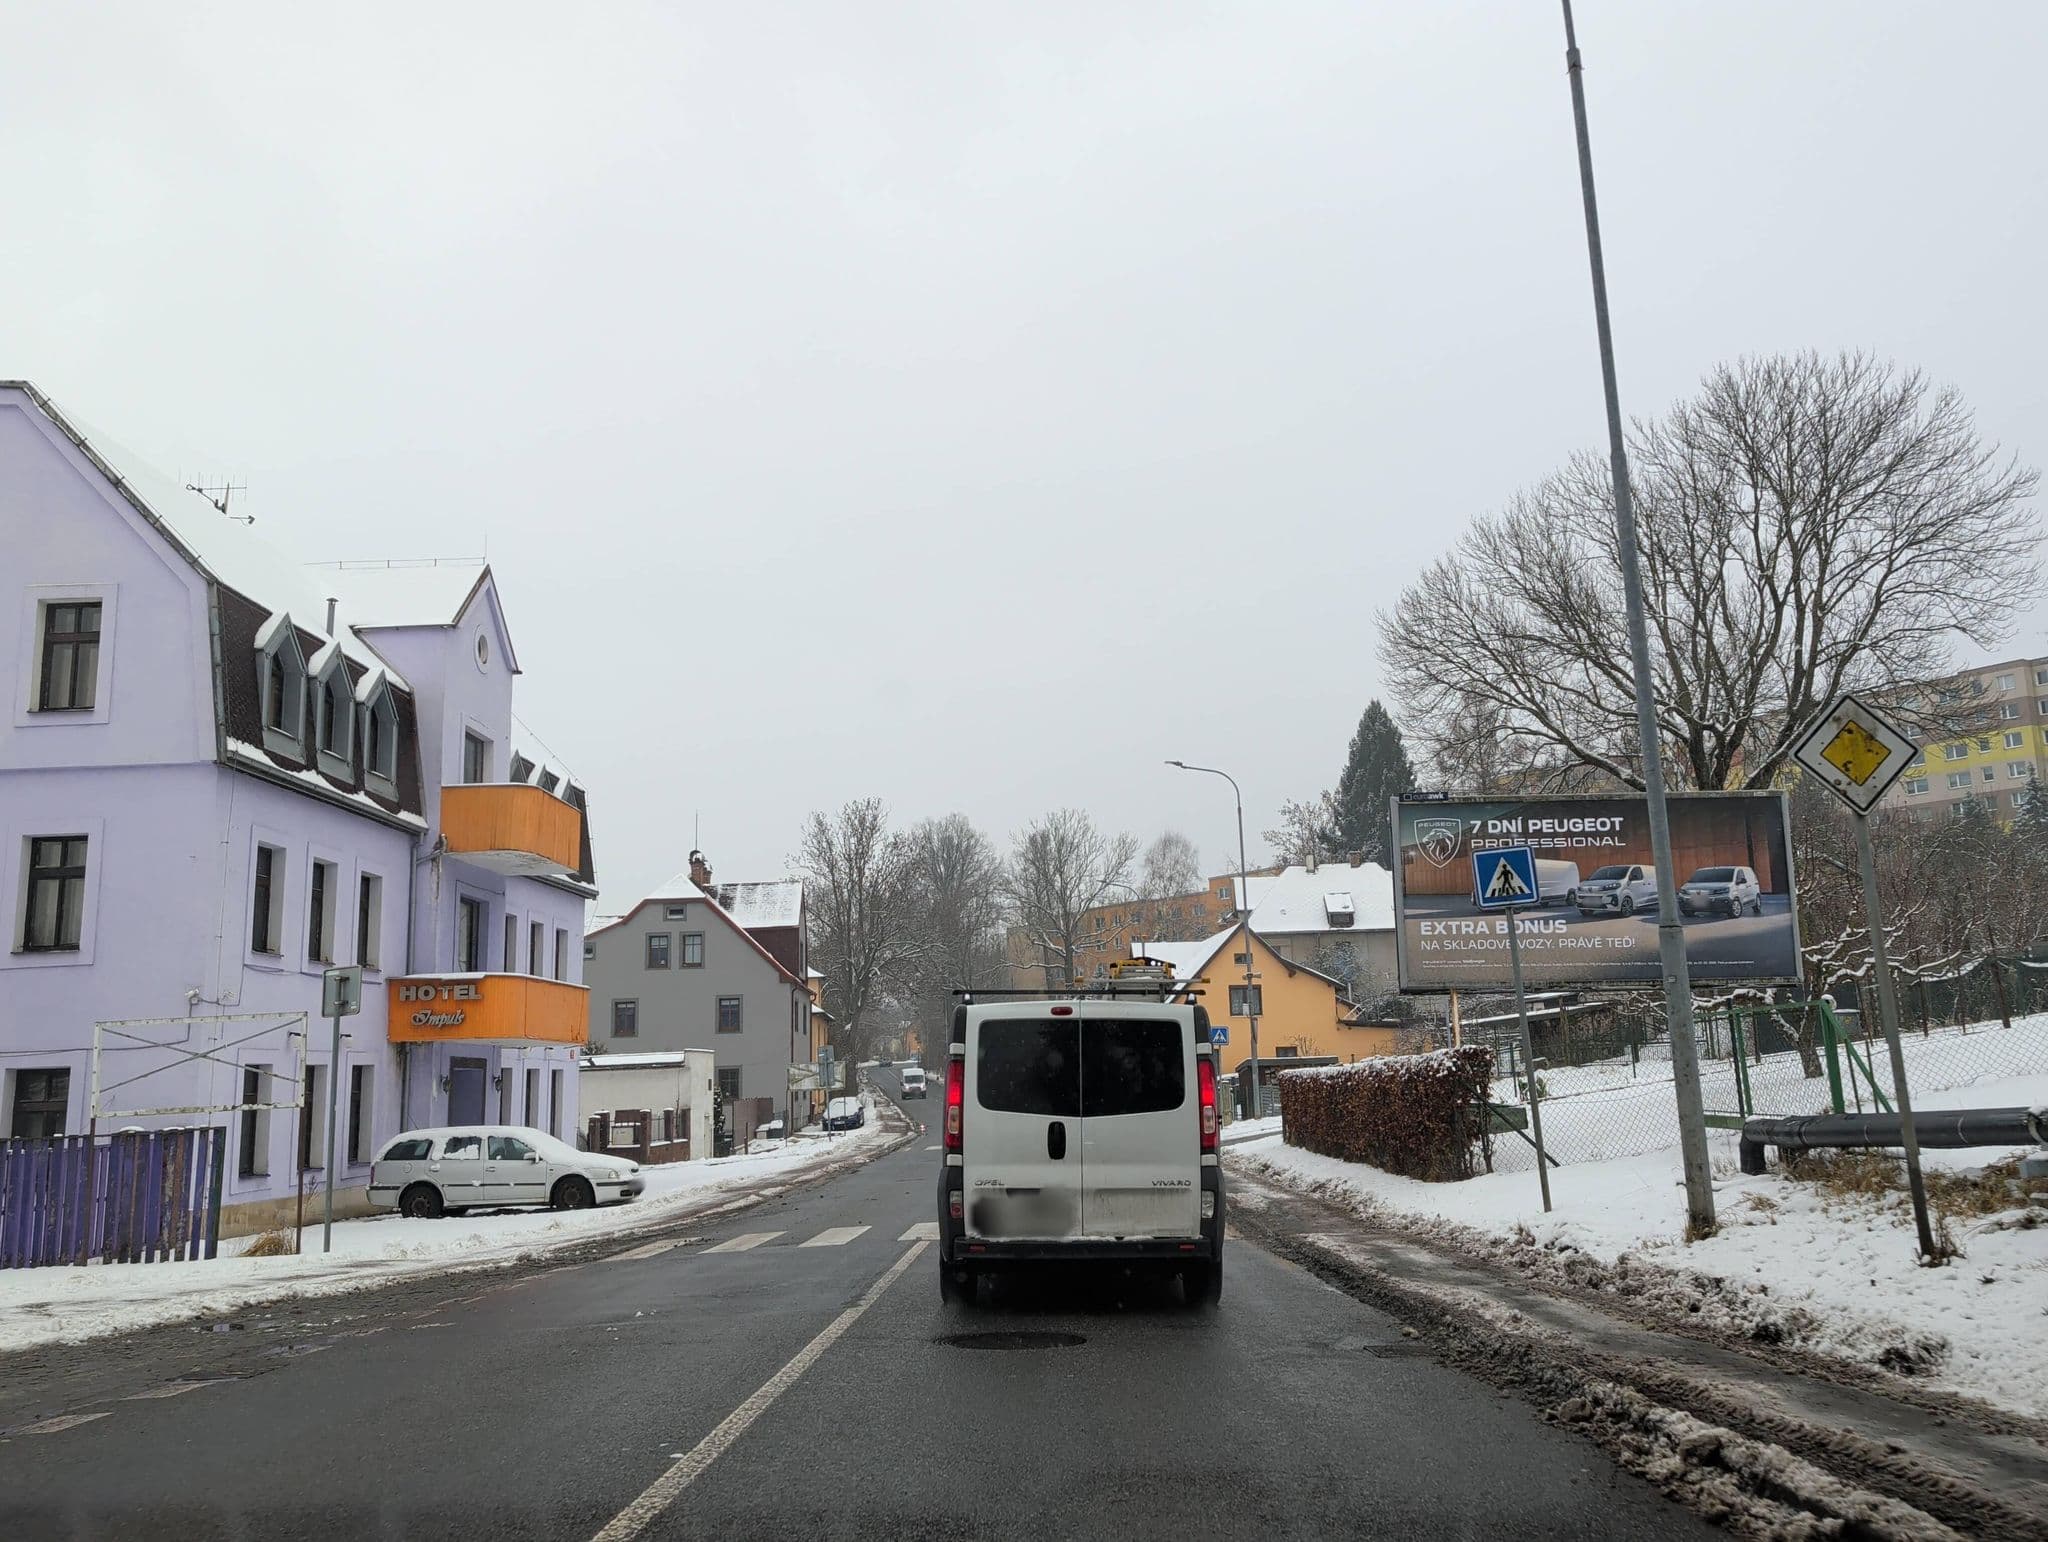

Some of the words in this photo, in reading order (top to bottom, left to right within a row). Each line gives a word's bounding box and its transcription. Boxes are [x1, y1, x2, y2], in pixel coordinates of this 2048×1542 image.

[1417, 820, 1457, 828] PEUGEOT
[1469, 820, 1482, 834] 7
[1487, 816, 1523, 834] DNÍ
[1528, 817, 1624, 833] PEUGEOT
[1471, 836, 1627, 849] PROFESSIONAL
[1420, 920, 1490, 936] EXTRA
[1495, 919, 1567, 935] BONUS
[1420, 939, 1440, 950] NA
[1559, 935, 1602, 948] PRÁVĚ
[1605, 936, 1636, 948] TEĎ!
[399, 984, 482, 1002] HOTEL
[411, 1008, 465, 1029] Impuls
[1151, 1179, 1192, 1187] VIVARO
